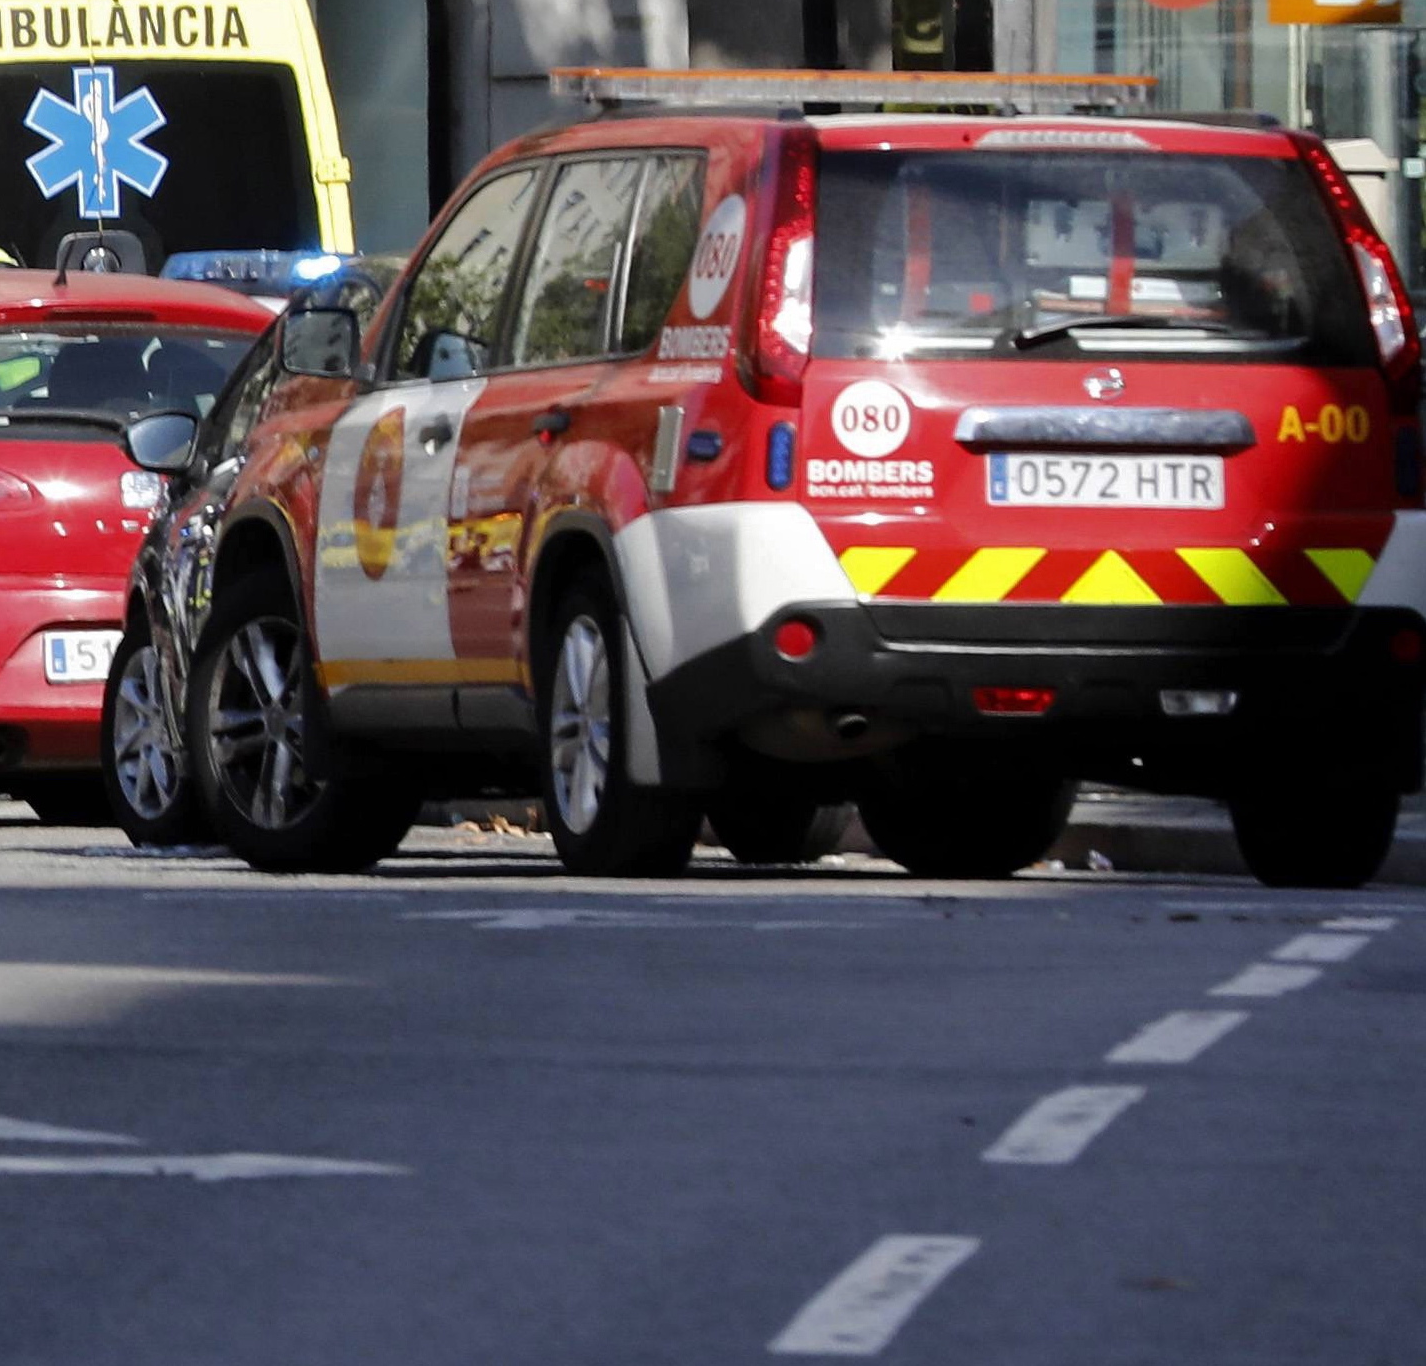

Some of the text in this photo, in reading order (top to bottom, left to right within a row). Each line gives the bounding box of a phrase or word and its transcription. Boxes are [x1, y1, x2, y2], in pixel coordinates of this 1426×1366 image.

[695, 233, 737, 279] 080
[657, 325, 733, 361] BOMBERS
[841, 404, 901, 433] 080
[1277, 405, 1369, 444] A-00
[807, 458, 935, 484] BOMBERS
[1017, 460, 1214, 501] 0572 HTR
